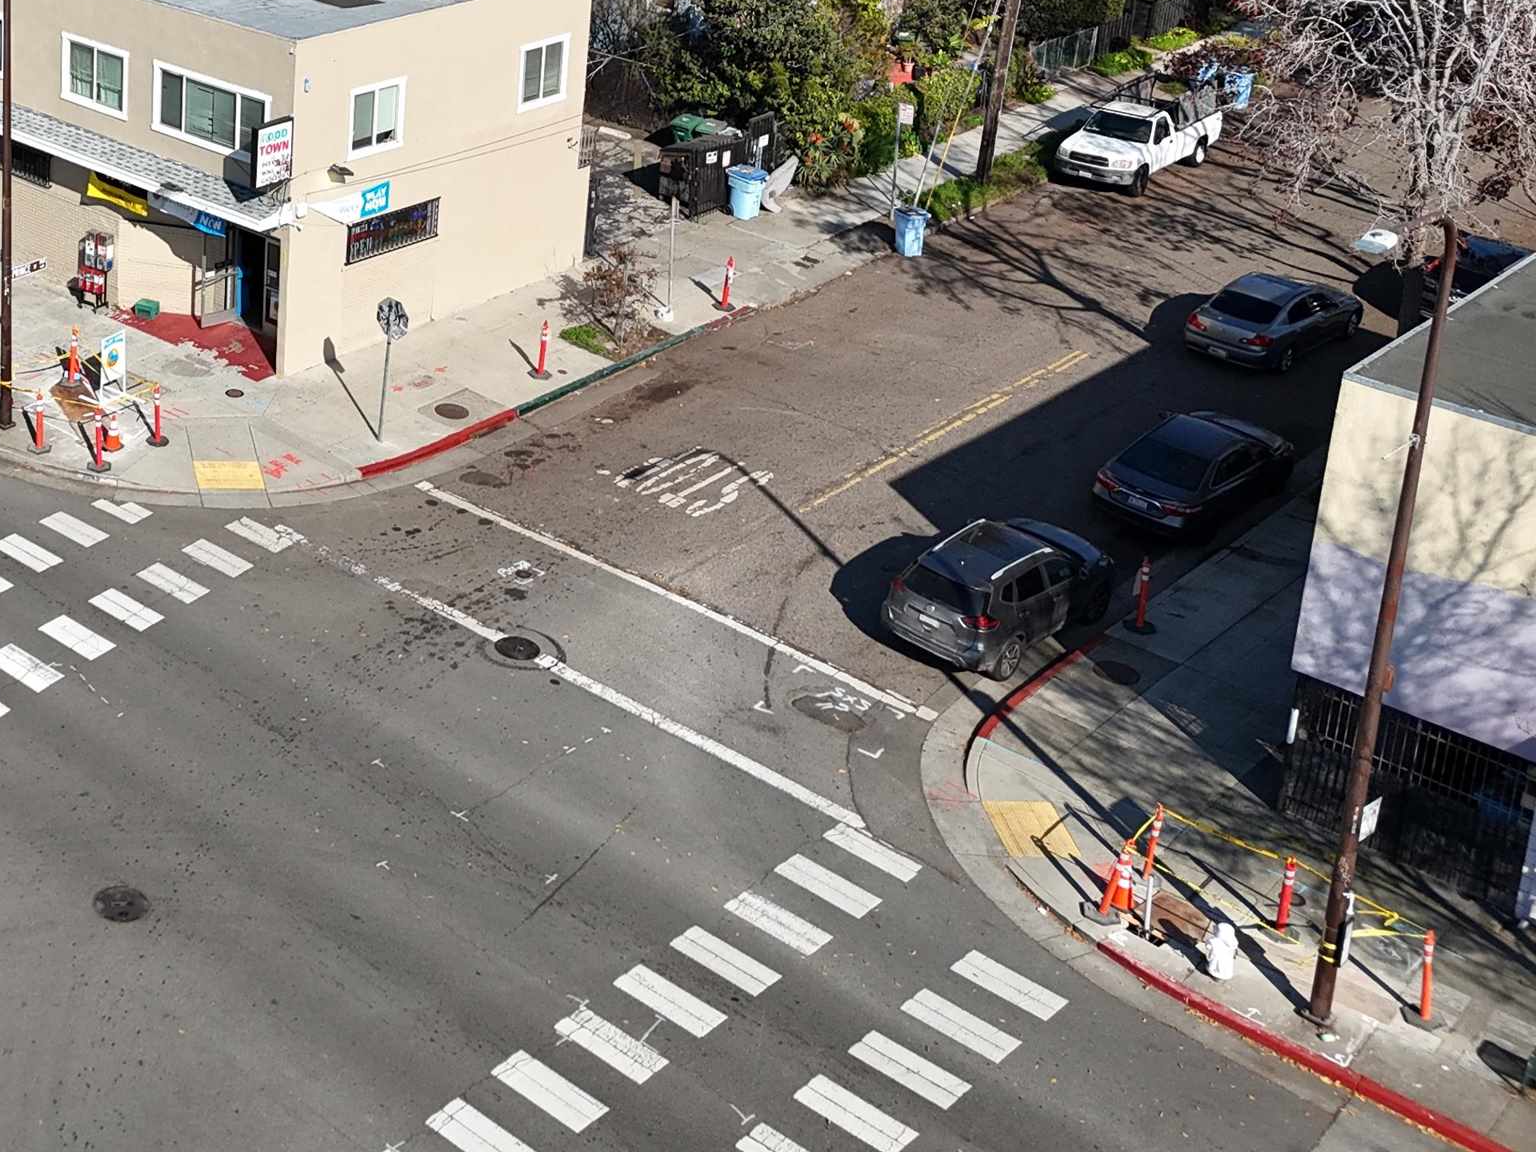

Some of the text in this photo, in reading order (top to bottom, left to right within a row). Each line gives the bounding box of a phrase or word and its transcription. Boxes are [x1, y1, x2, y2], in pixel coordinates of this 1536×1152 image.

[259, 139, 290, 157] TOWN
[365, 186, 388, 201] PLAY
[365, 197, 387, 211] NOW
